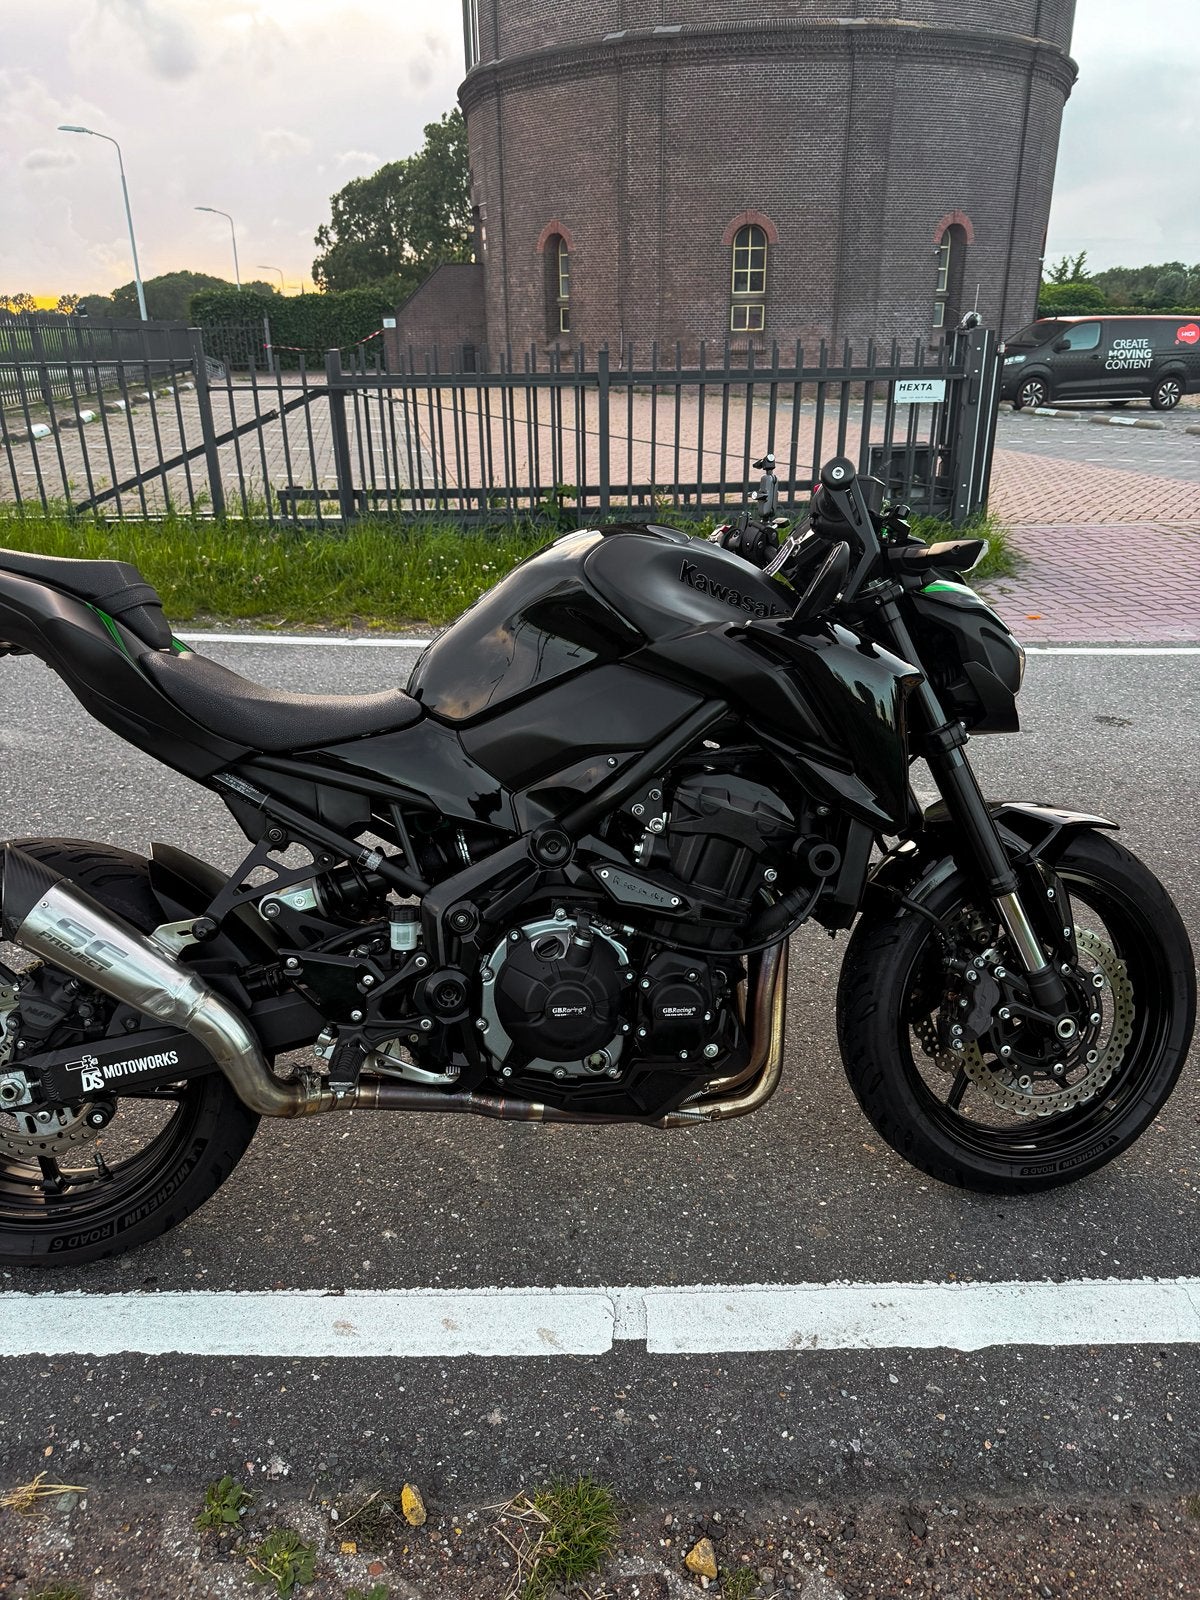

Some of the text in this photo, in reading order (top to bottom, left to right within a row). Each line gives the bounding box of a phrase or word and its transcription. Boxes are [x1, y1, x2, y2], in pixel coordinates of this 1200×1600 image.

[1108, 349, 1152, 360] MOVING
[1113, 338, 1149, 349] CREATE
[1105, 359, 1153, 370] CONTENT
[899, 383, 932, 391] HEXTA
[680, 559, 791, 618] Kawasak
[39, 930, 108, 972] PROJECT
[56, 917, 129, 969] SC
[81, 1050, 179, 1092] DS MOTOWORKS
[124, 1162, 191, 1227] MICHELIN
[68, 1225, 111, 1247] ROAD
